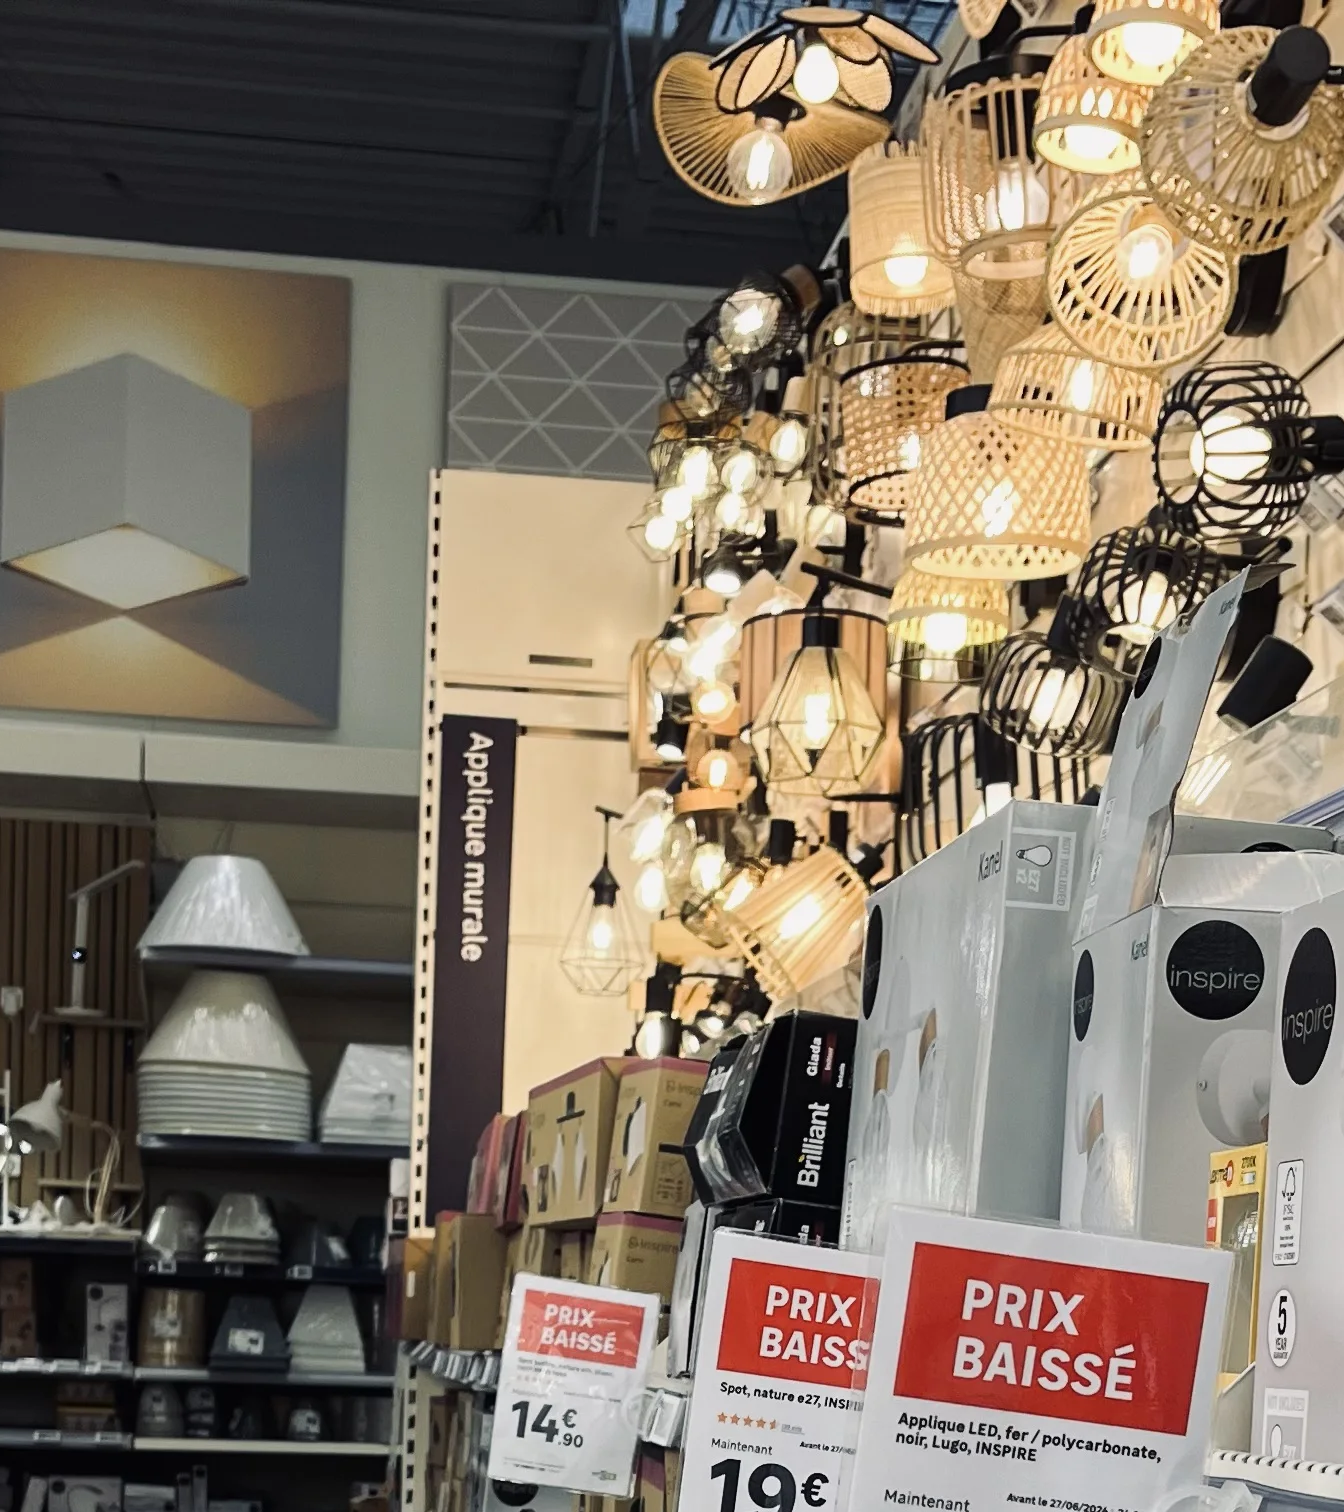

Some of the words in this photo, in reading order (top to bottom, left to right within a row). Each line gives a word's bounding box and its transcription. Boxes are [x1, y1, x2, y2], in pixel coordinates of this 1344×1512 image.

[460, 731, 494, 857] Applique
[460, 861, 489, 962] murale
[1170, 963, 1261, 995] inspire
[1282, 997, 1334, 1045] inspire
[796, 1101, 831, 1188] Brilliant
[544, 1303, 596, 1328] PRIX
[765, 1284, 857, 1328] PRIX
[960, 1277, 1085, 1336] PRIX
[1276, 1295, 1288, 1336] 5
[539, 1326, 618, 1356] BAISSÉ
[759, 1325, 870, 1371] BAISS
[952, 1334, 1137, 1402] BAISSÉ
[720, 1381, 751, 1399] Spot,
[754, 1387, 795, 1403] nature
[797, 1392, 822, 1408] e27,
[511, 1400, 560, 1443] 14
[562, 1408, 578, 1429] €
[897, 1411, 966, 1434] Applique
[968, 1421, 1003, 1441] LED,
[1005, 1425, 1029, 1443] fer
[1030, 1428, 1041, 1445] /
[1041, 1432, 1162, 1464] polycarbonate,
[710, 1437, 773, 1456] Maintenant
[895, 1431, 928, 1449] noir,
[932, 1435, 972, 1456] Lugo,
[975, 1441, 1038, 1462] INSPIRE
[800, 1472, 830, 1508] €
[1006, 1493, 1036, 1506] Avant
[1037, 1496, 1048, 1507] le
